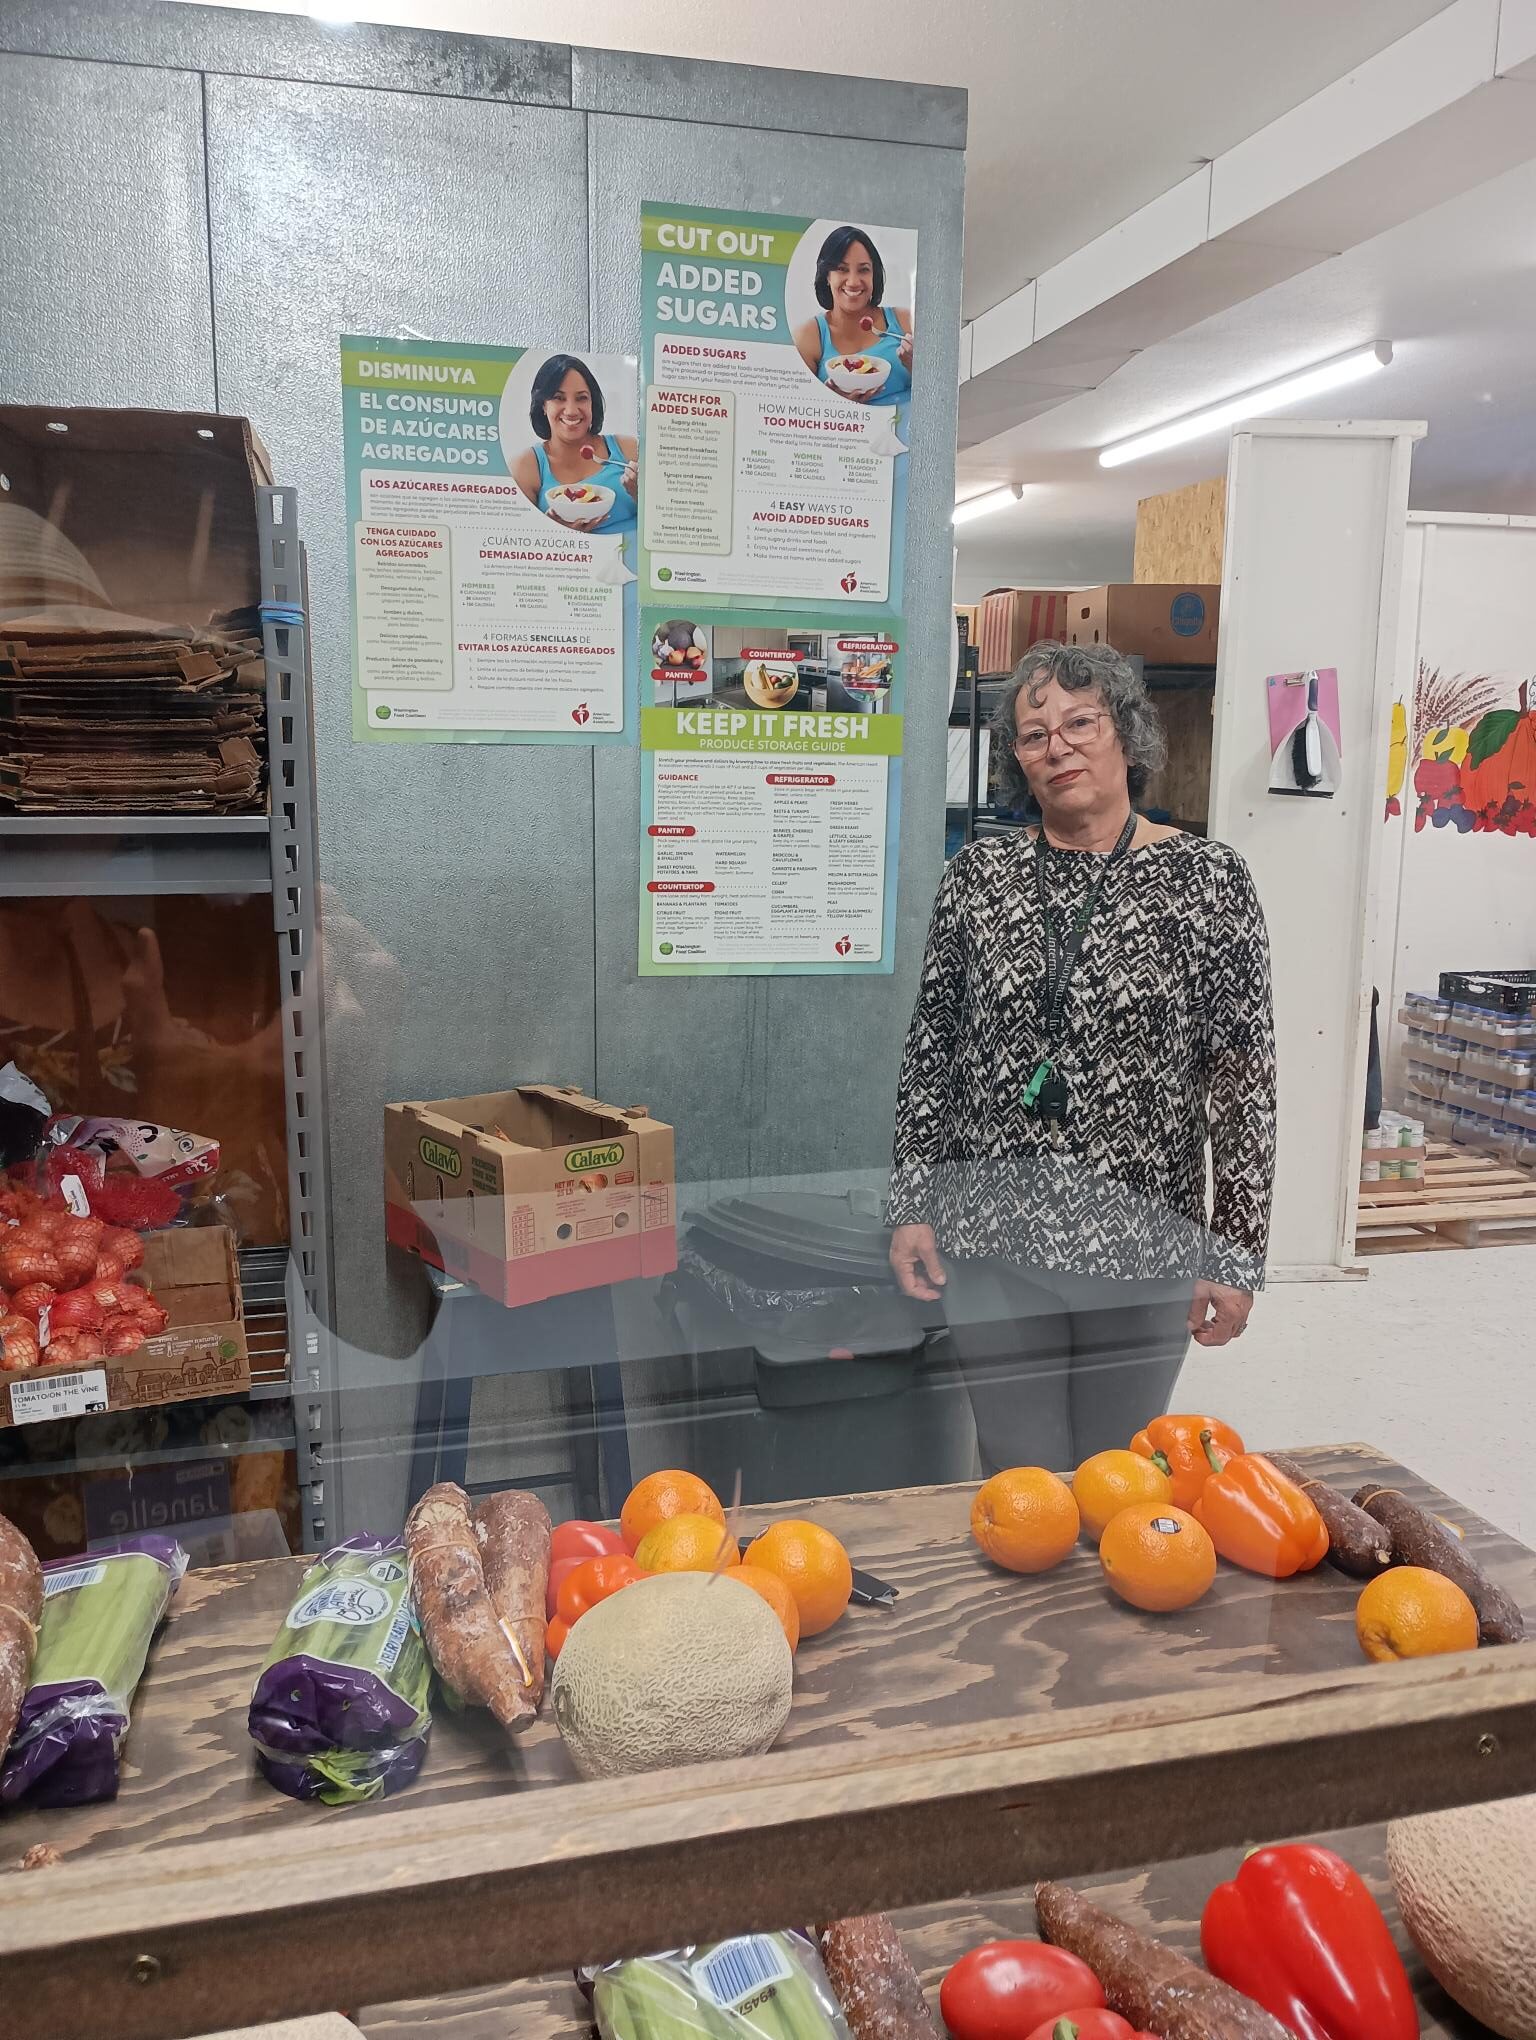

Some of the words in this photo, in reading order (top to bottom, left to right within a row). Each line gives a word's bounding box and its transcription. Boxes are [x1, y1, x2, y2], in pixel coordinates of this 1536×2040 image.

[657, 224, 712, 251] CUT
[717, 232, 774, 257] OUT
[656, 262, 762, 295] ADDED
[656, 296, 777, 331] SUGARS
[662, 345, 700, 356] ADDED
[703, 348, 747, 360] SUGARS
[358, 360, 476, 384] DISMINUYA
[360, 392, 382, 410] EL
[386, 395, 494, 417] CONSUMO
[658, 392, 697, 403] WATCH
[700, 396, 720, 405] FOR
[651, 403, 688, 414] ADDED
[691, 407, 728, 417] SUGAR
[759, 403, 785, 414] HOW
[789, 405, 820, 417] MUCH
[824, 409, 859, 420] SUGAR
[862, 412, 870, 421] IS
[360, 418, 388, 436] DE
[392, 417, 499, 442] AZÚCARES
[764, 417, 786, 426] TOO
[789, 419, 820, 429] MUCH
[824, 422, 865, 432] SUGAR?
[361, 442, 489, 466] AGREGADOS
[370, 480, 390, 489] LOS
[393, 479, 449, 492] AZÚCARES
[451, 485, 517, 496] AGREGADOS
[770, 501, 776, 509] 4
[780, 502, 805, 511] EASY
[808, 503, 836, 513] WAYS
[840, 505, 853, 514] TO
[753, 512, 786, 522] AVOID
[789, 515, 825, 525] ADDED
[828, 517, 869, 528] SUGARS
[366, 528, 395, 536] TENGA
[397, 529, 436, 537] CUIDADO
[399, 539, 443, 548] AZÚCARES
[483, 536, 531, 547] ¿CUÁNTO
[535, 537, 575, 549] AZÚCAR
[579, 541, 589, 549] ES
[376, 550, 428, 558] AGREGADOS
[479, 550, 543, 560] DEMASIADO
[546, 552, 592, 563] AZÚCAR?
[530, 635, 577, 643] SENCILLAS
[511, 644, 558, 653] AZÚCARES
[749, 650, 796, 659] COUNTERTOP
[843, 643, 893, 651] REFRIGERATOR
[665, 671, 693, 679] PANTRY
[677, 711, 746, 736] KEEP
[753, 715, 778, 737] IT
[784, 716, 869, 739] FRESH
[700, 739, 754, 750] PRODUCE
[758, 740, 809, 751] STORAGE
[812, 741, 846, 752] GUIDE
[423, 1141, 457, 1172] Calavo
[571, 1149, 618, 1168] Calavo
[14, 1392, 61, 1403] TOMATO/ON
[729, 1984, 777, 2018] #9457
